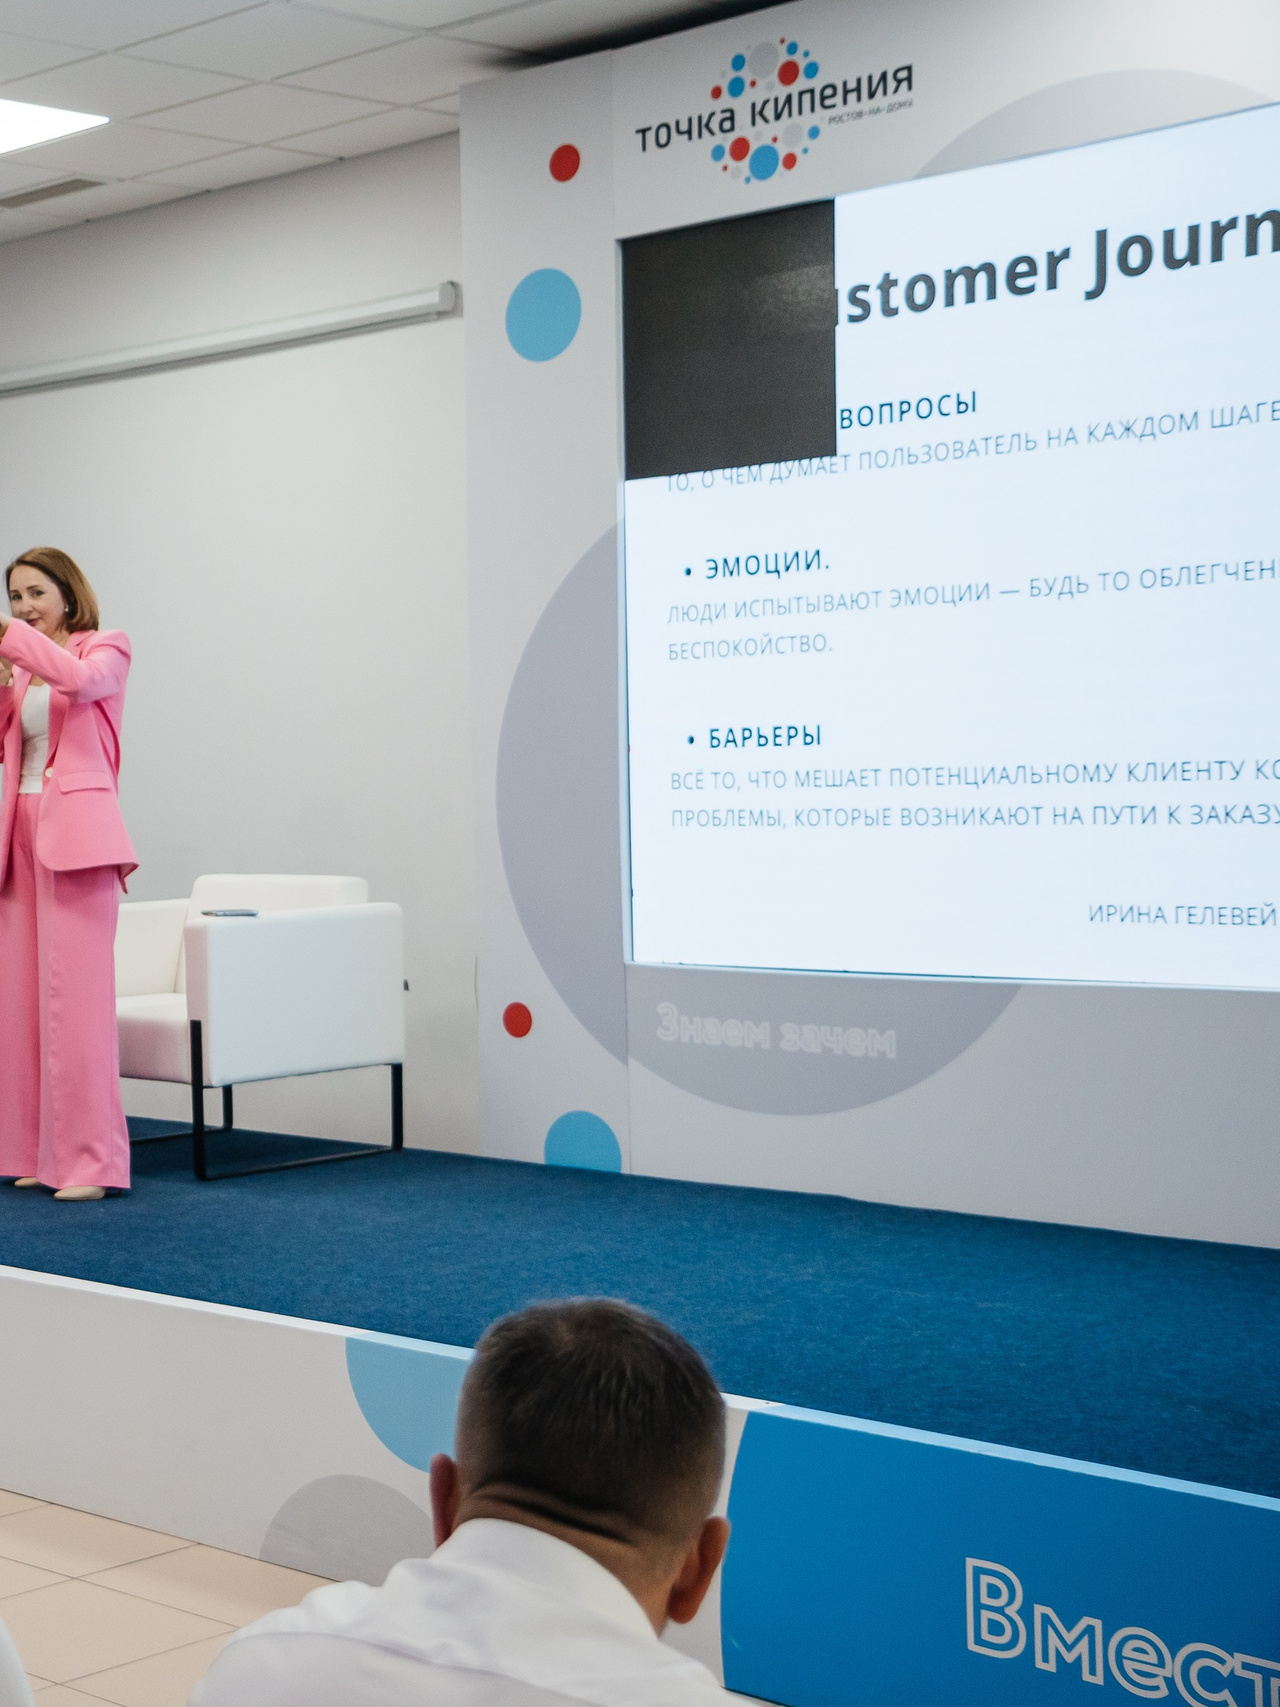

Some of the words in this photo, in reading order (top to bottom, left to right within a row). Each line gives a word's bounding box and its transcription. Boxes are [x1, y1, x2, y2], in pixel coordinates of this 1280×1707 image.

[635, 108, 735, 152] точка
[750, 64, 913, 126] кипения
[834, 247, 1071, 323] stomer
[839, 390, 977, 429] ВОПРОСЫ
[769, 454, 850, 484] ДУМАЕТ
[858, 432, 1038, 470] ПОЛЬЗОВАТЕЛЬ
[1046, 427, 1078, 449] НА
[1087, 410, 1199, 443] КАЖДОМ
[705, 548, 830, 579] ЭМОЦИИ.
[667, 602, 726, 625] ЛЮДИ
[734, 590, 882, 618] ИСПЫТЫВАЮТ
[889, 582, 990, 607] ЭМОЦИИ
[1029, 576, 1089, 600] БУДЬ
[1097, 570, 1130, 592] ТО
[1139, 559, 1280, 589] ОБЛЕГЧЕН
[669, 632, 833, 661] БЕСПОКОЙСТВО.
[709, 724, 821, 749] БАРЬЕРЫ
[671, 768, 704, 790] ВСЁ
[711, 771, 741, 792] ТО,
[748, 770, 787, 789] ЧТО
[795, 768, 882, 788] МЕШАЕТ
[890, 763, 1118, 789] ПОТЕНЦИАЛЬНОМУ
[1127, 760, 1245, 782] КЛИЕНТУ
[671, 809, 787, 829] ПРОБЛЕМЫ,
[795, 808, 892, 827] КОТОРЫЕ
[900, 806, 1043, 827] ВОЗНИКАЮТ
[1053, 806, 1084, 825] НА
[1092, 805, 1157, 825] ПУТИ
[1168, 805, 1182, 825] К
[1088, 904, 1168, 925] ИРИНА
[1175, 902, 1277, 927] ГЕЛЕВЕЙ
[656, 1001, 770, 1049] Знаем
[779, 1022, 897, 1059] зачем
